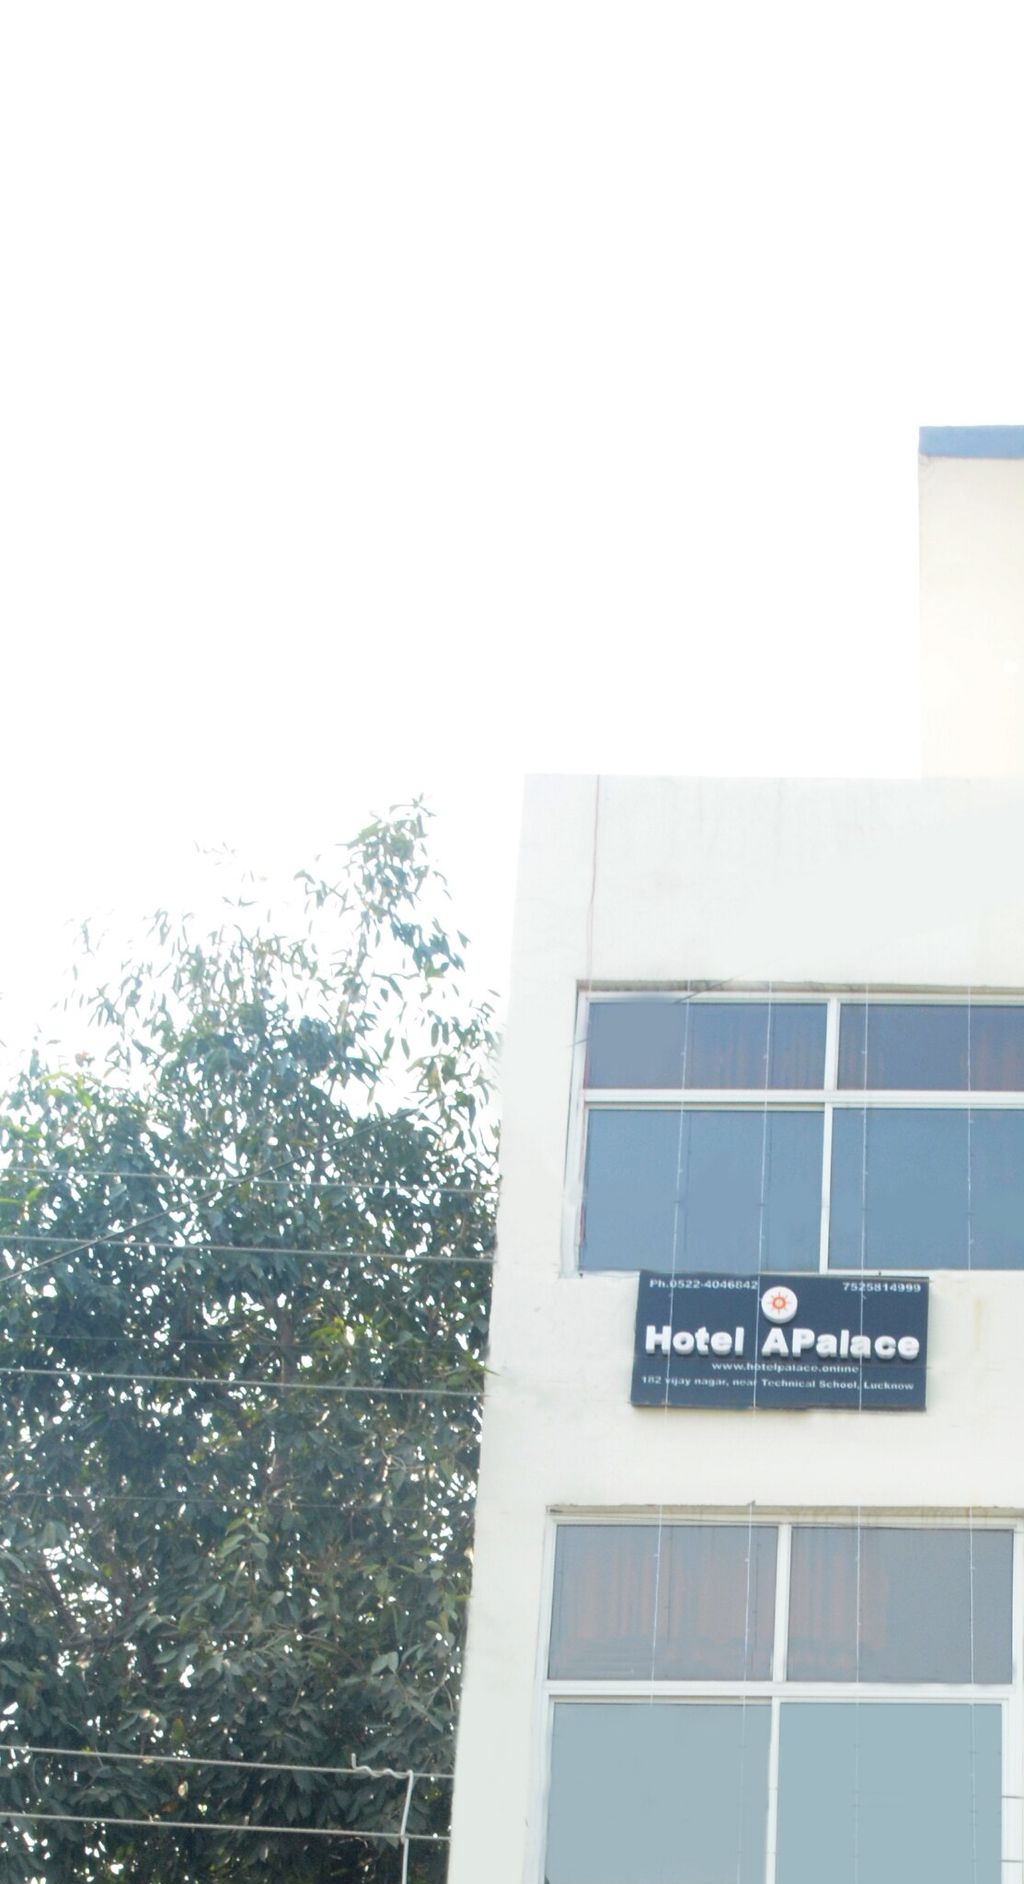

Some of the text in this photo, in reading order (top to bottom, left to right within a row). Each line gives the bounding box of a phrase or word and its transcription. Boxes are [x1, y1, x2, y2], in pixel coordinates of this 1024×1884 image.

[645, 1325, 745, 1356] Hotel
[761, 1378, 816, 1388] Technical
[864, 1380, 914, 1391] Lucknow
